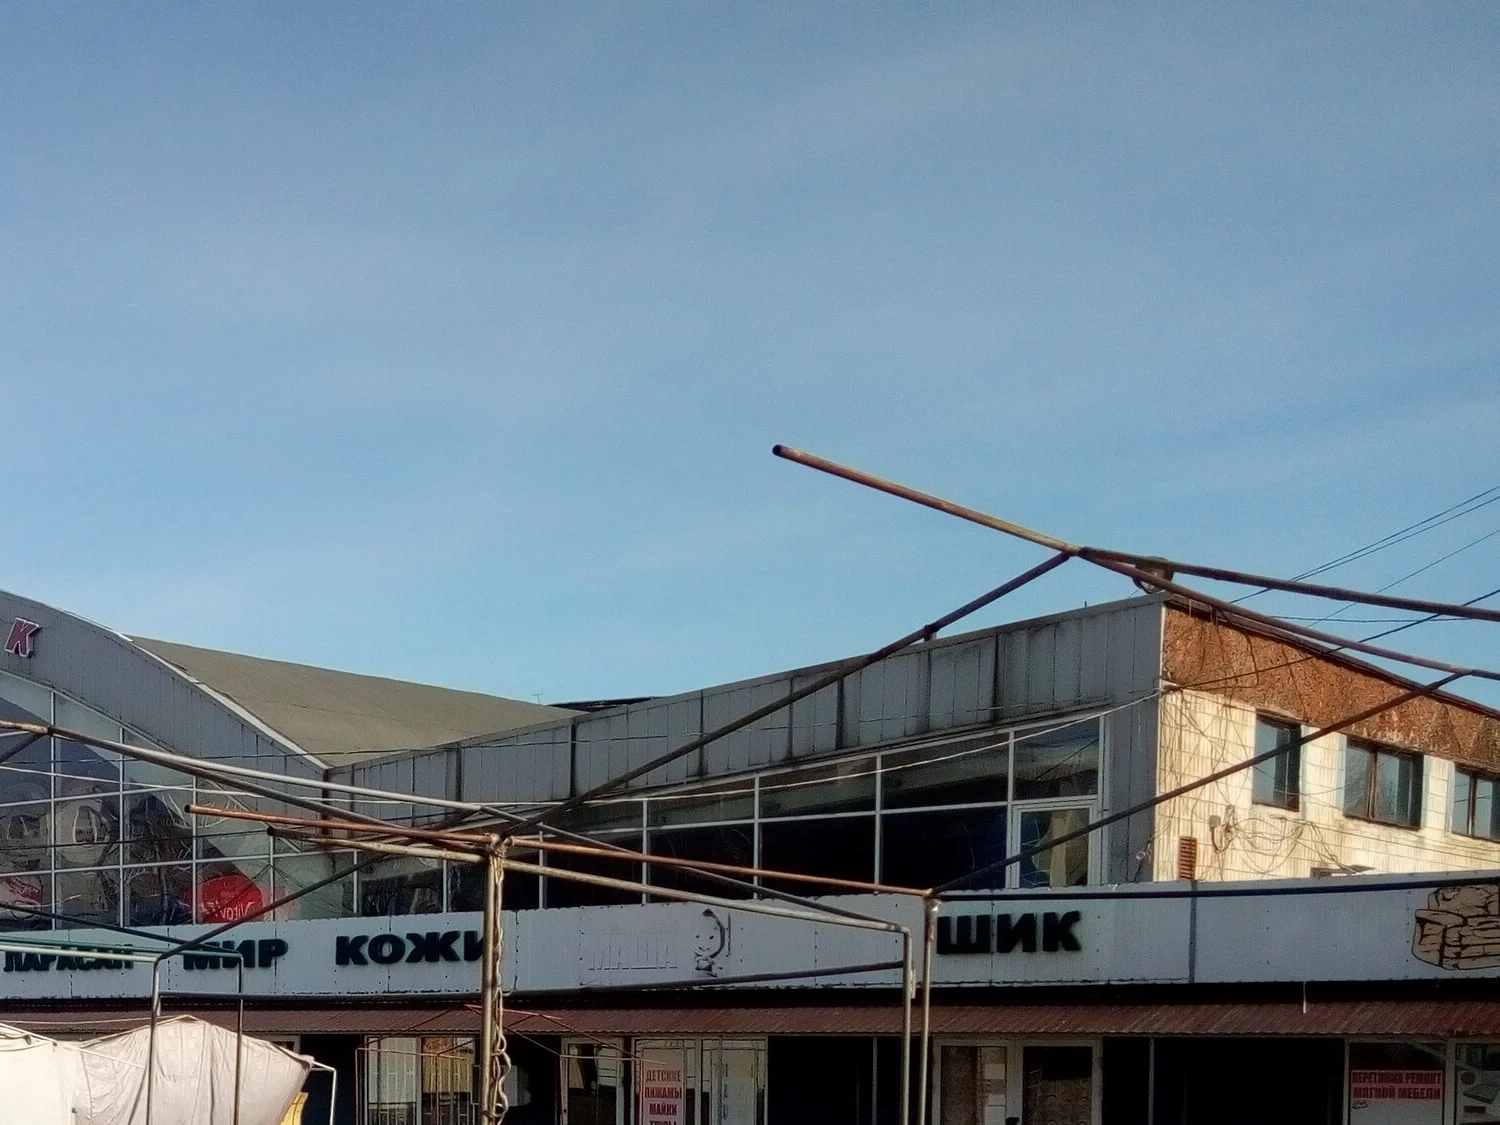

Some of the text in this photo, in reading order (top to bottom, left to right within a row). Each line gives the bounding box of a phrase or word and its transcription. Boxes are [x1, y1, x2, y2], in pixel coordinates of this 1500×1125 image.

[937, 910, 1083, 954] ШИК
[183, 939, 289, 970] МИР
[644, 1087, 682, 1099] ПИЖАМЫ
[649, 1102, 677, 1116] МАЙКИ
